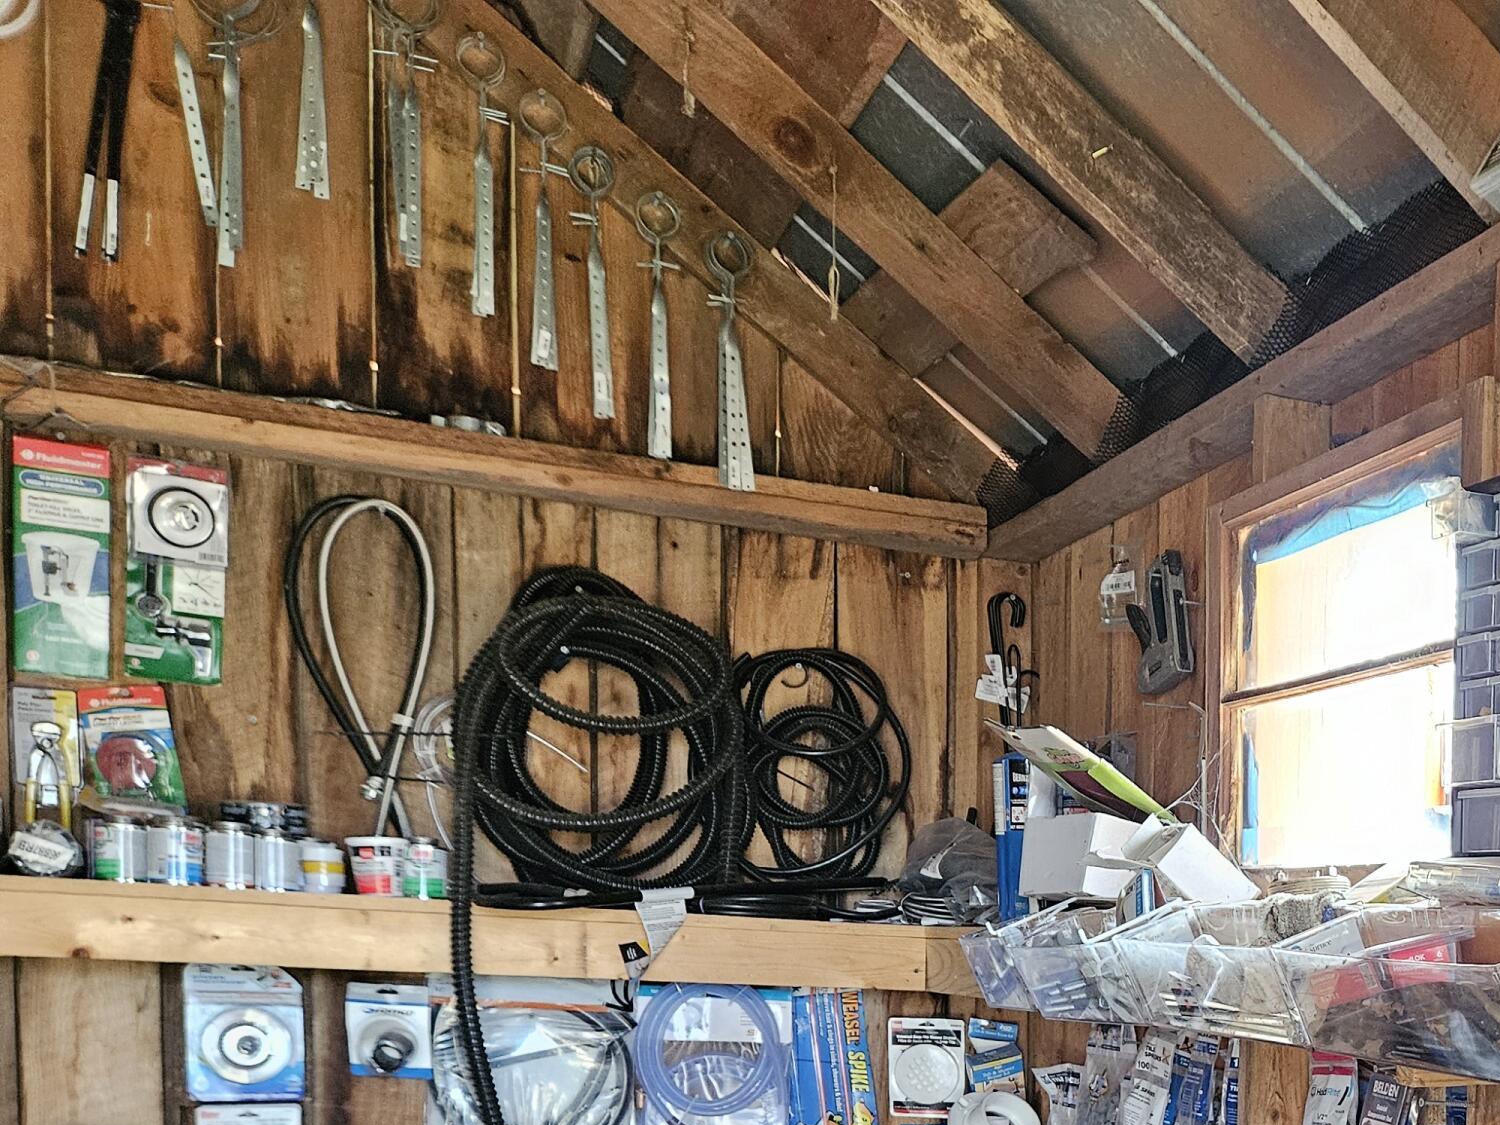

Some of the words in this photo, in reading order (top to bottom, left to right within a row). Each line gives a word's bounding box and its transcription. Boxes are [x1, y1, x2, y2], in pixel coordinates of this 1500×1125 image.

[841, 990, 861, 1046] WEASEL
[847, 1050, 870, 1094] SPIKE
[1372, 1079, 1401, 1098] BELDEN
